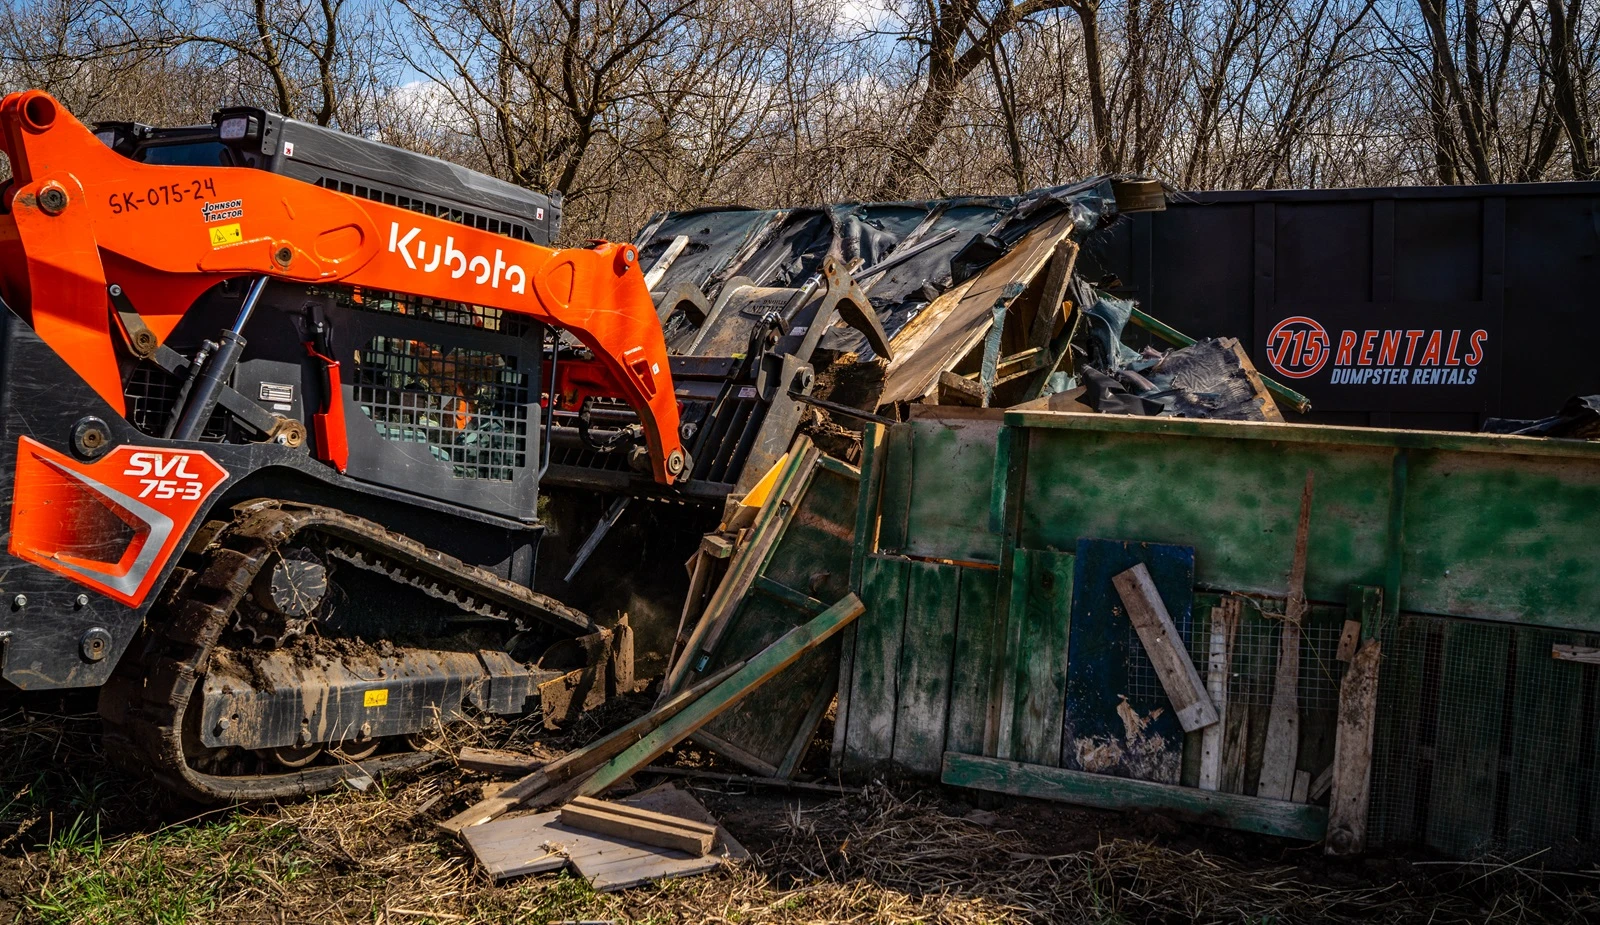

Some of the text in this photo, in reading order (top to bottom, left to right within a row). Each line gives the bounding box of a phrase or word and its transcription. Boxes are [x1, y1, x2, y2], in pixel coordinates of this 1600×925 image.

[109, 177, 217, 214] SK-075-24
[202, 199, 242, 213] JOHNSON
[204, 210, 243, 222] TRACTOR
[388, 221, 526, 295] Kubota
[1272, 329, 1488, 367] 715 RENTALS
[1329, 368, 1478, 385] DUMPSTER RENTALS
[123, 452, 200, 479] SVL
[138, 479, 203, 500] 75-3
